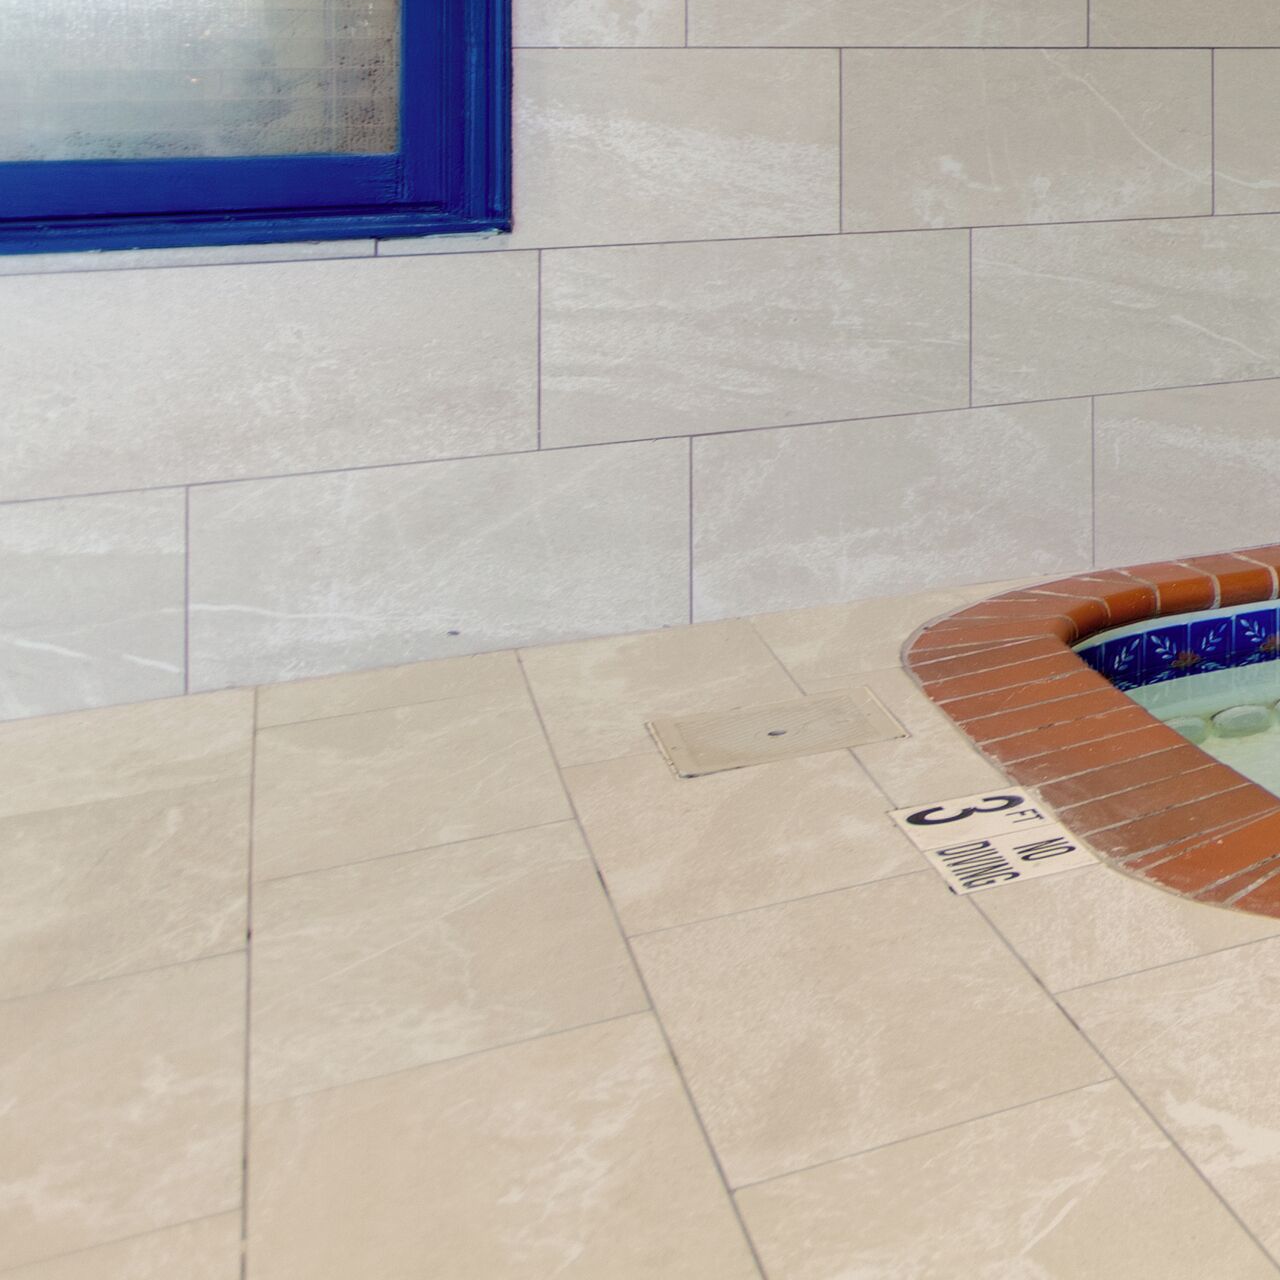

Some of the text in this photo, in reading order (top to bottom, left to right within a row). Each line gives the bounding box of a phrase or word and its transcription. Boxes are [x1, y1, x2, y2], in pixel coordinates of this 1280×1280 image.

[906, 795, 1044, 826] 3 FT
[1013, 836, 1077, 862] NO
[937, 840, 1020, 890] DIVING
